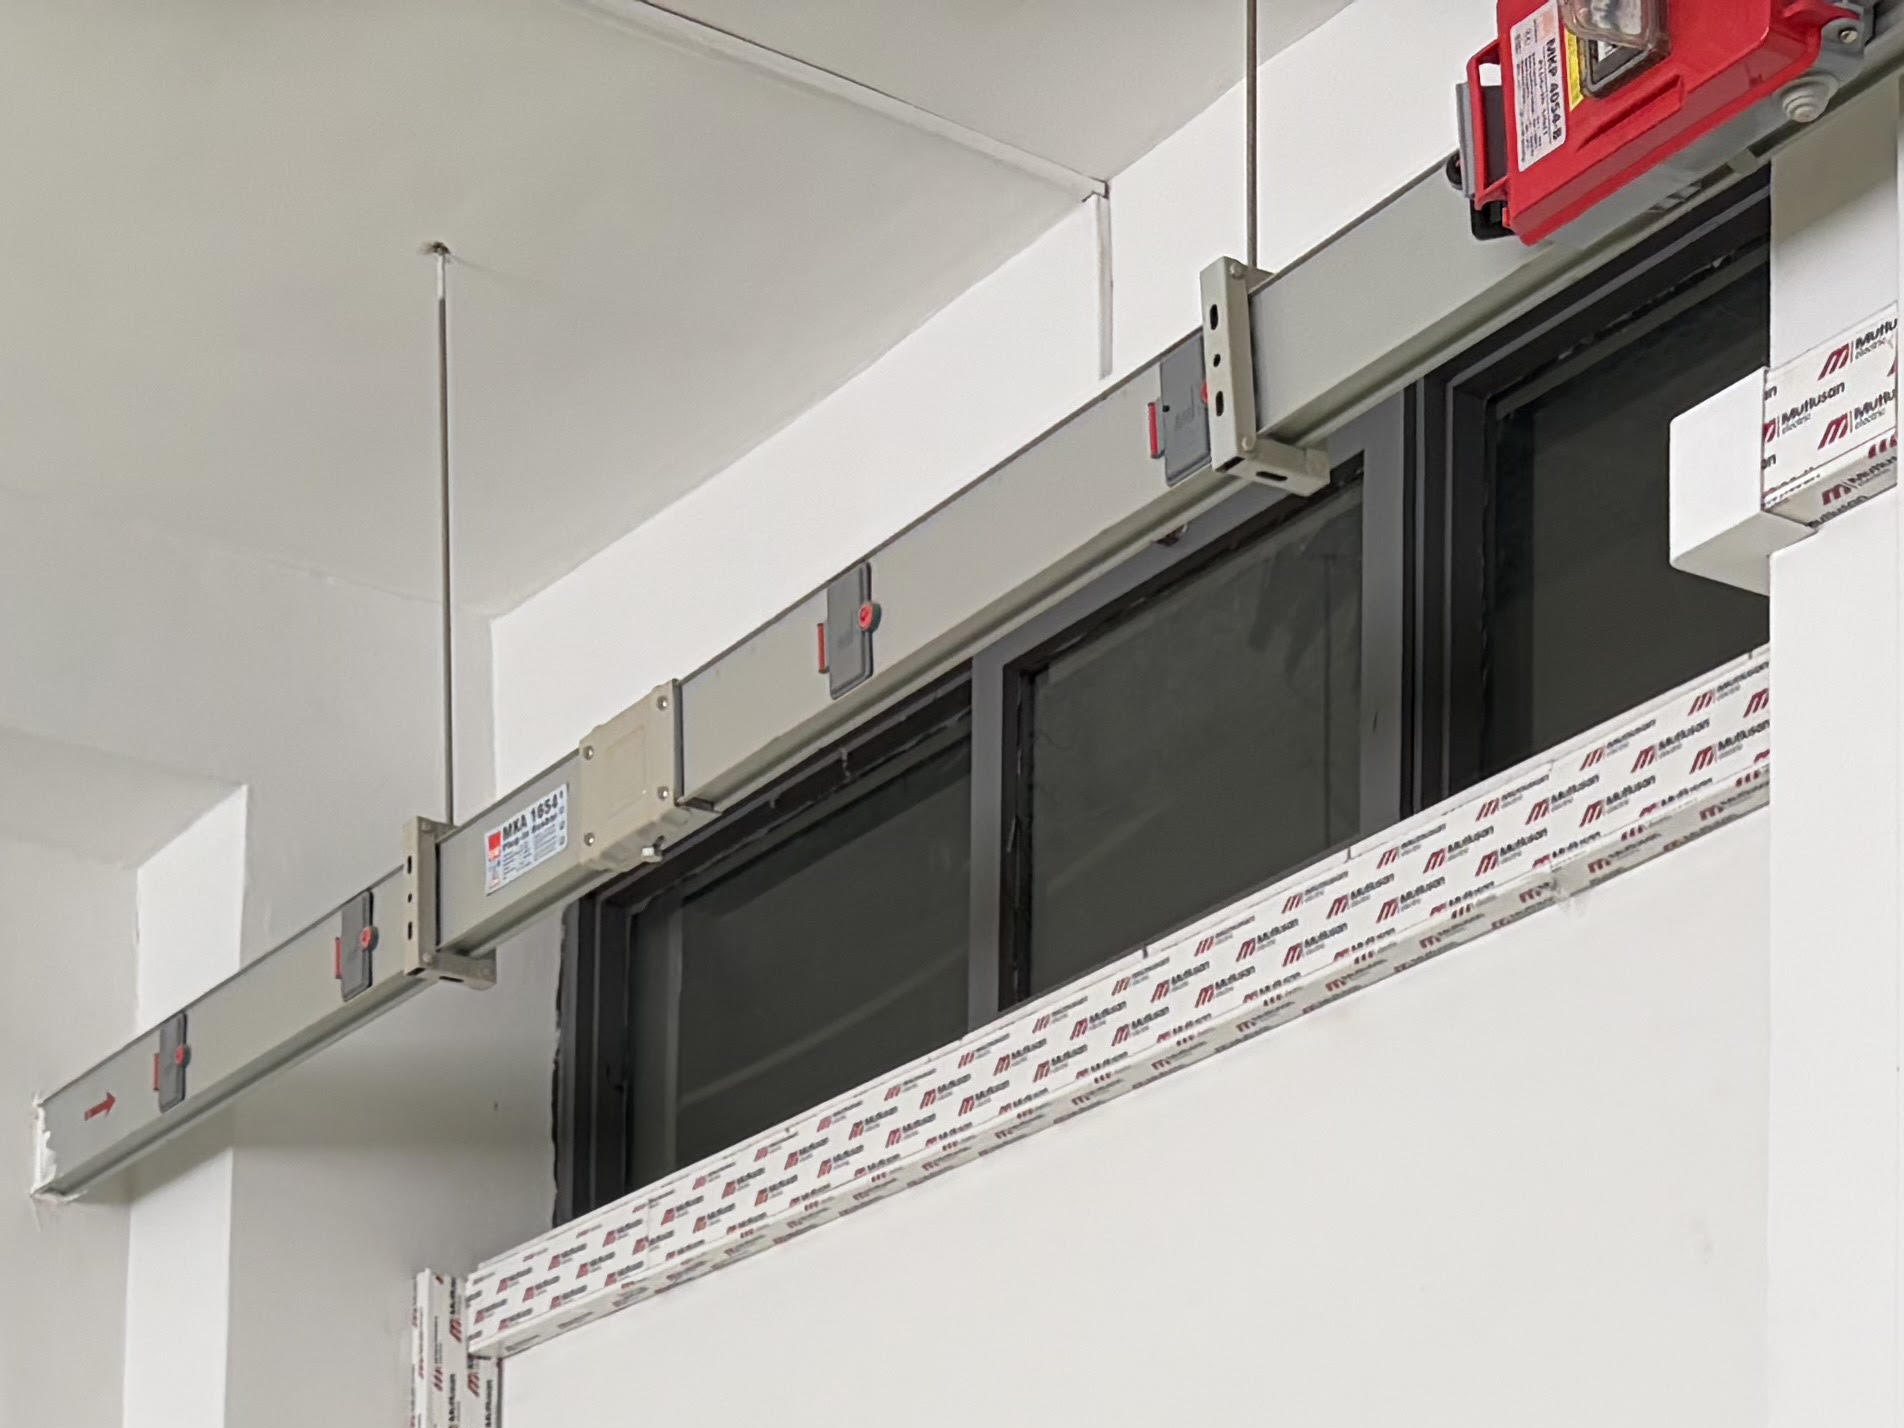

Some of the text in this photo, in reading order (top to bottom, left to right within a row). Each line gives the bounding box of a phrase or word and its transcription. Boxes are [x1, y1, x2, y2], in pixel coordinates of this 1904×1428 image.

[1855, 318, 1898, 350] Mutlu
[1781, 381, 1845, 426] Mutlusan
[1854, 389, 1897, 420] Mutlu
